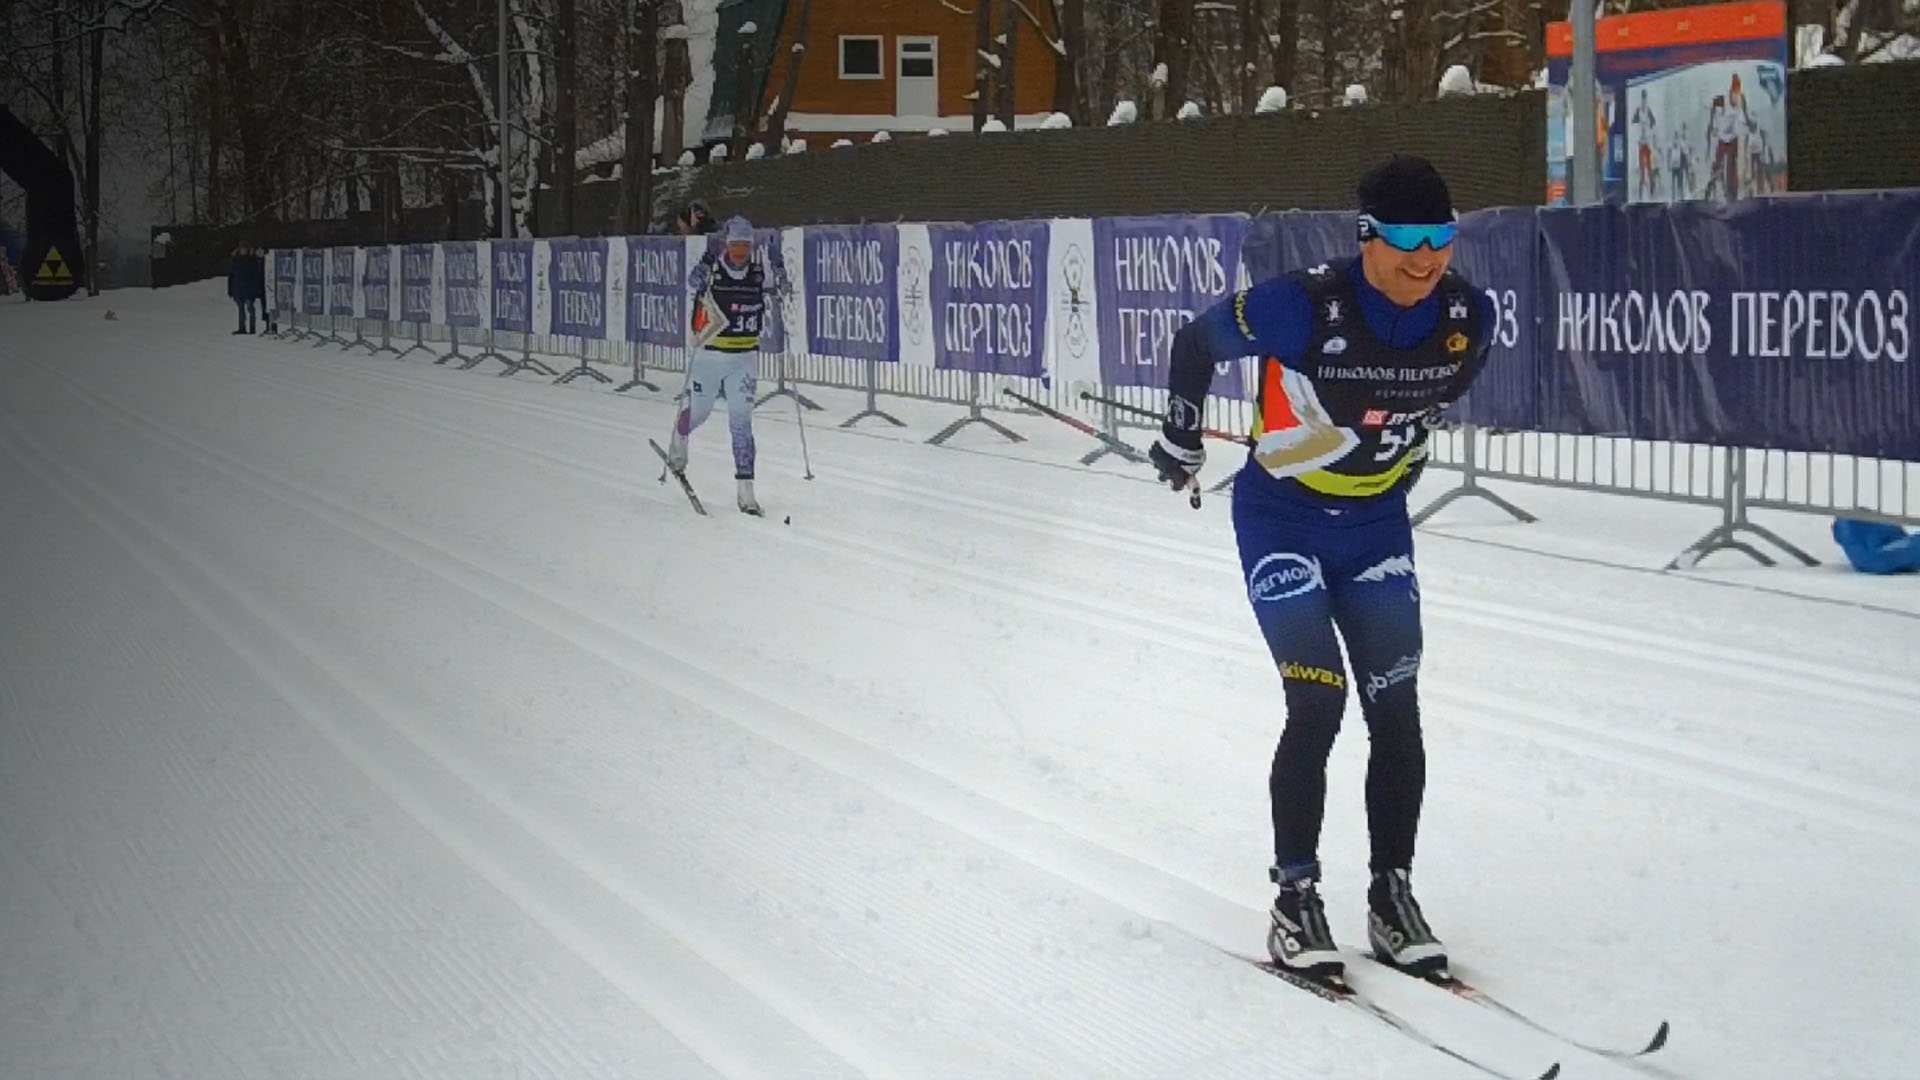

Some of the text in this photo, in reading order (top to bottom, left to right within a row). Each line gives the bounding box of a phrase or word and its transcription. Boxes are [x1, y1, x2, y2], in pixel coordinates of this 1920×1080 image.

[1115, 235, 1227, 297] НИКОЛОВ
[815, 296, 886, 343] ПЕРЕВОЗ
[1556, 289, 1712, 354] НИКОЛОВ
[1730, 289, 1910, 362] ПЕРЕВОЗ
[1317, 366, 1397, 381] НИКОЛОВ
